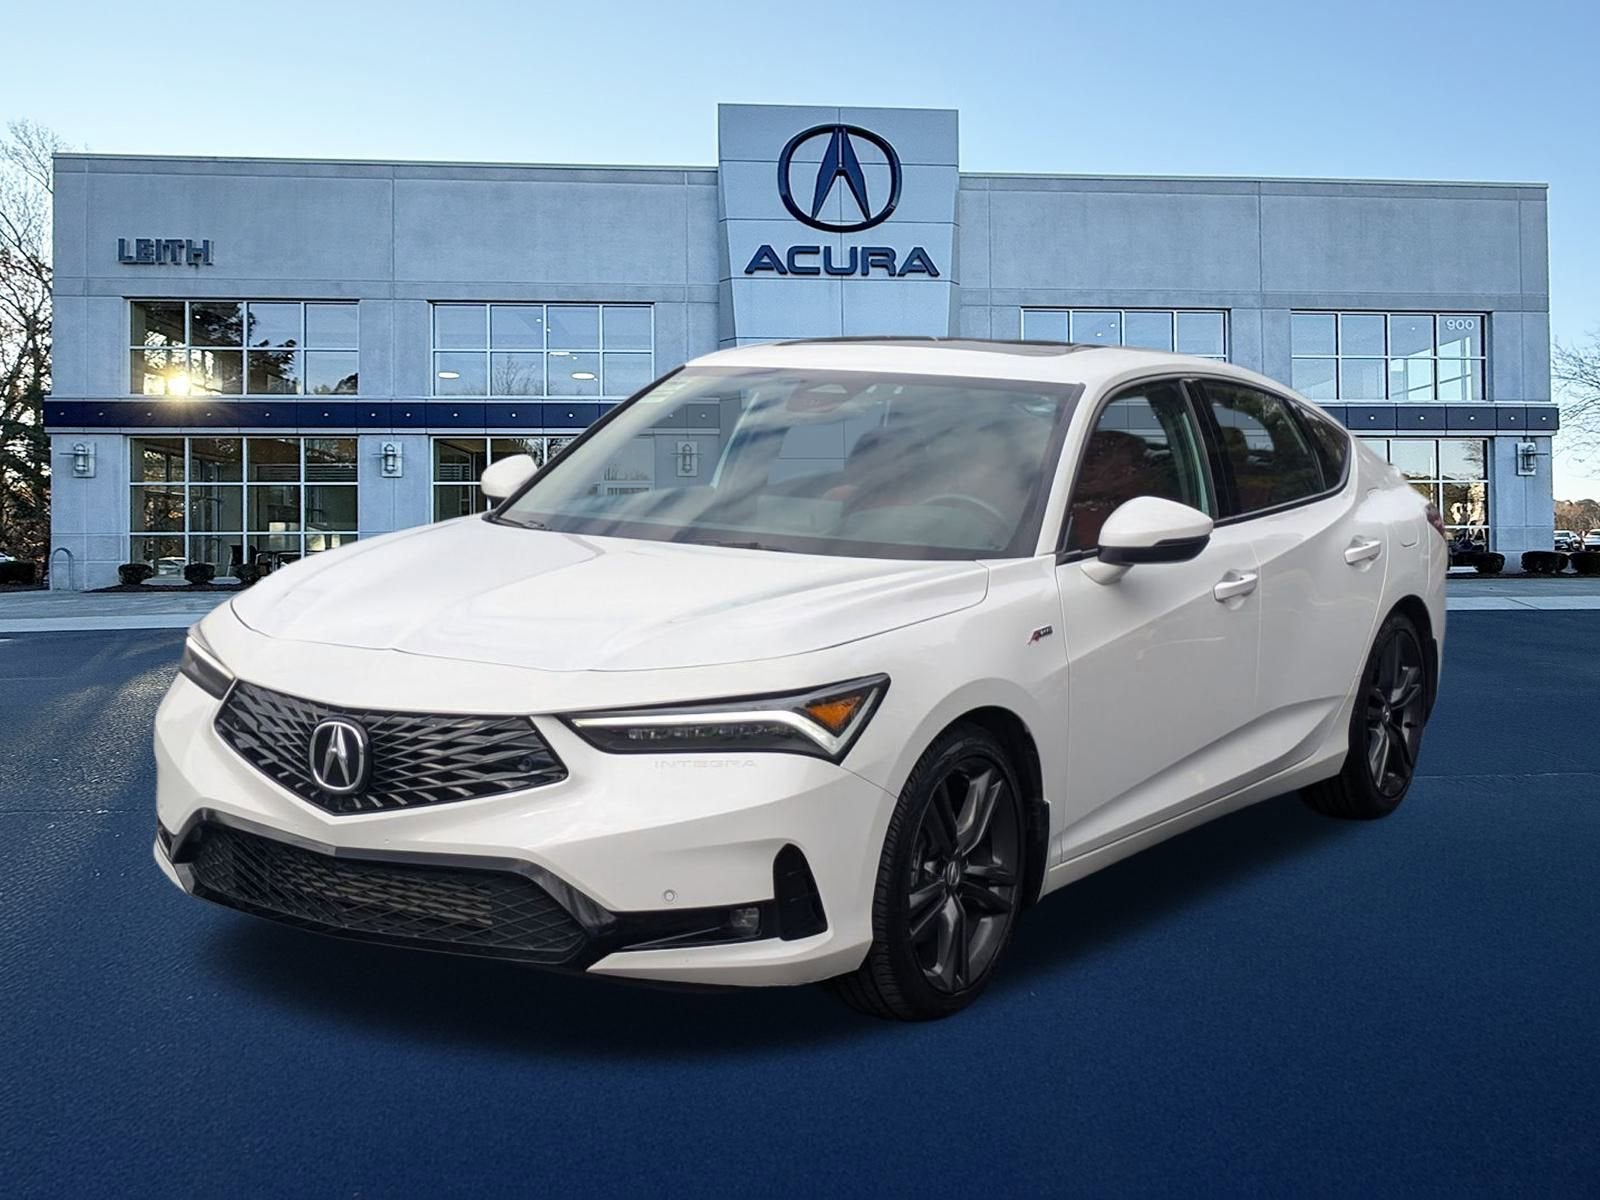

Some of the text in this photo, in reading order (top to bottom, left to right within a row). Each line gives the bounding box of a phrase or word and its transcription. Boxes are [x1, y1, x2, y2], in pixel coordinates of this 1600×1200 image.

[118, 238, 211, 264] LEITH
[744, 244, 940, 277] ACURA
[1446, 319, 1474, 330] 900
[653, 759, 758, 769] INTEGRA
